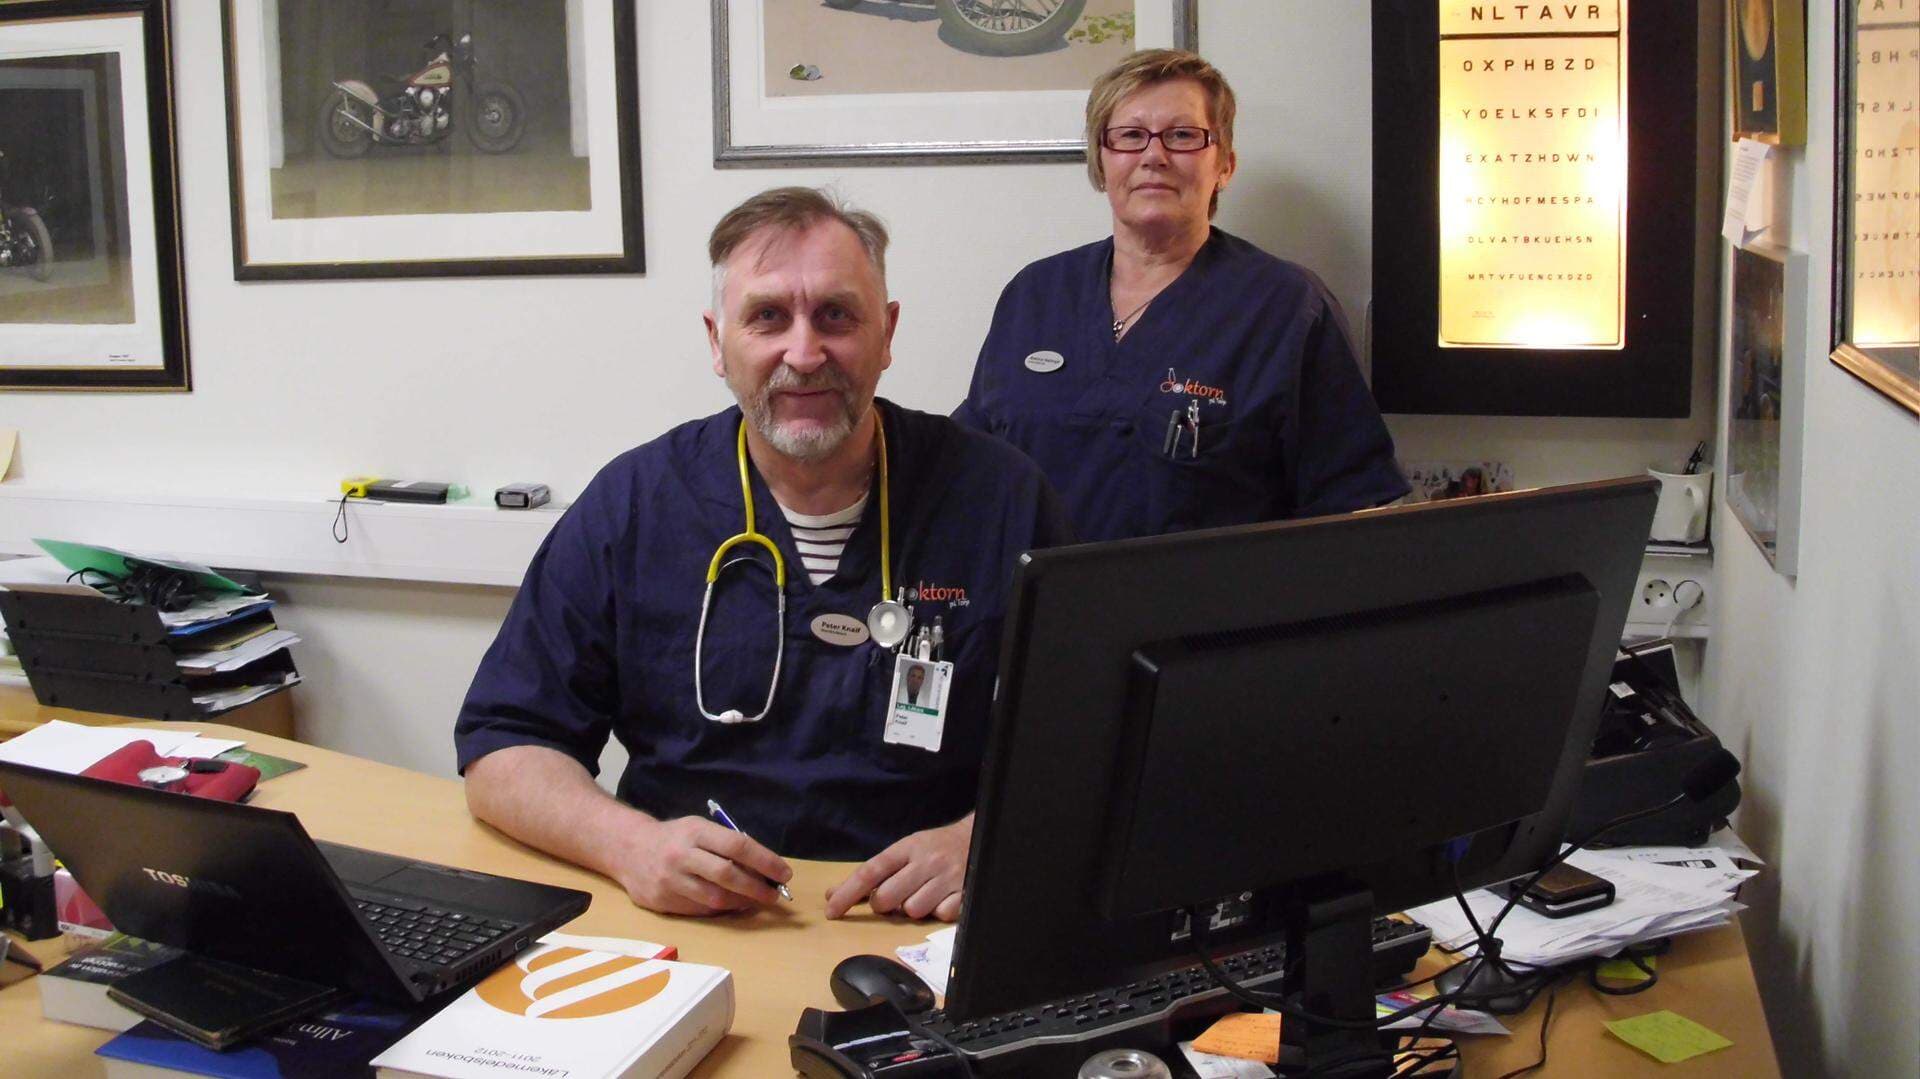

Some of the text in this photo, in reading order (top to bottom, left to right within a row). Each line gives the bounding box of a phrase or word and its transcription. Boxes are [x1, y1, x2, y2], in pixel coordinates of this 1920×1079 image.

[1471, 5, 1600, 21] NLTAVR
[1463, 58, 1595, 72] OXPHBZD
[1462, 107, 1598, 120] YOELKSFDI
[1465, 153, 1595, 163] EXATZHDWN
[142, 867, 191, 888] TOS
[296, 1024, 354, 1041] Allm
[425, 1048, 570, 1078] Läkemedelsboken
